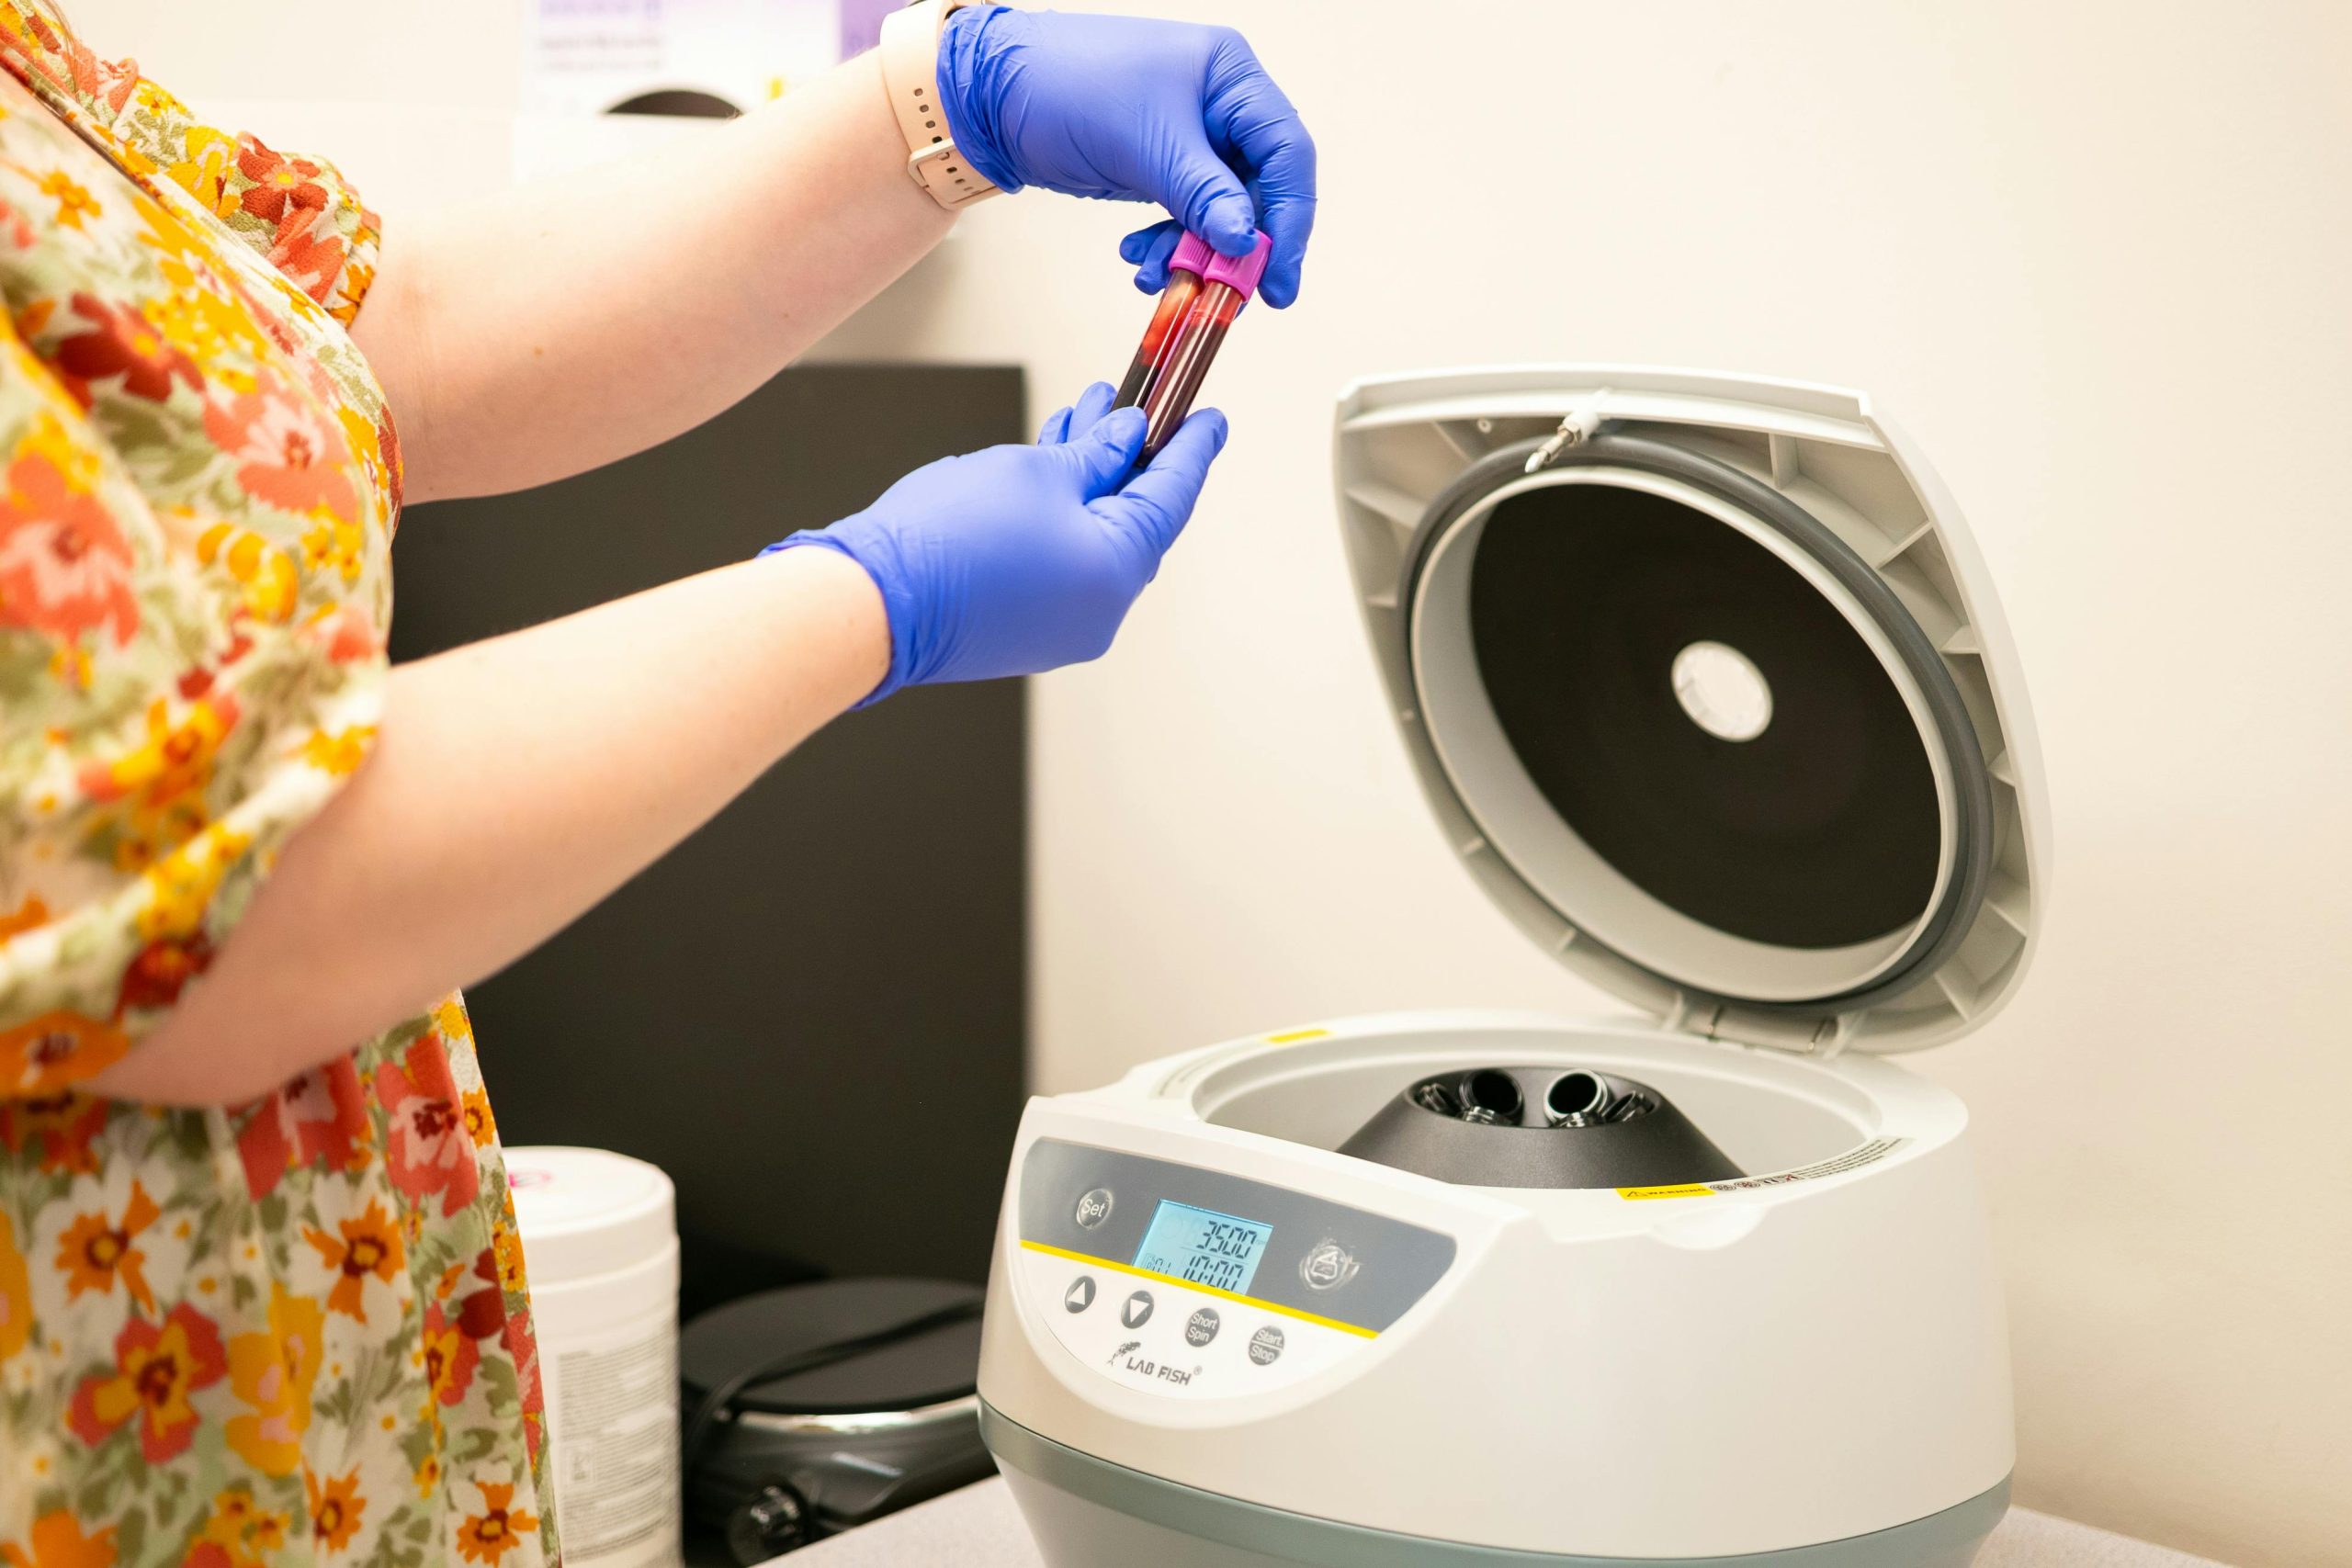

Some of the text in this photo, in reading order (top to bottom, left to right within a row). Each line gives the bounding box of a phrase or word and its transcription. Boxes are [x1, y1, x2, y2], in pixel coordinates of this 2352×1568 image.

[1081, 1198, 1105, 1217] Set
[1195, 1220, 1257, 1259] 3500
[1183, 1255, 1244, 1292] 10:00
[1191, 1312, 1218, 1330] Short
[1187, 1325, 1210, 1342] Spin
[1256, 1329, 1283, 1347] Start
[1250, 1344, 1275, 1364] Stop
[1125, 1356, 1192, 1386] LAB FISH
